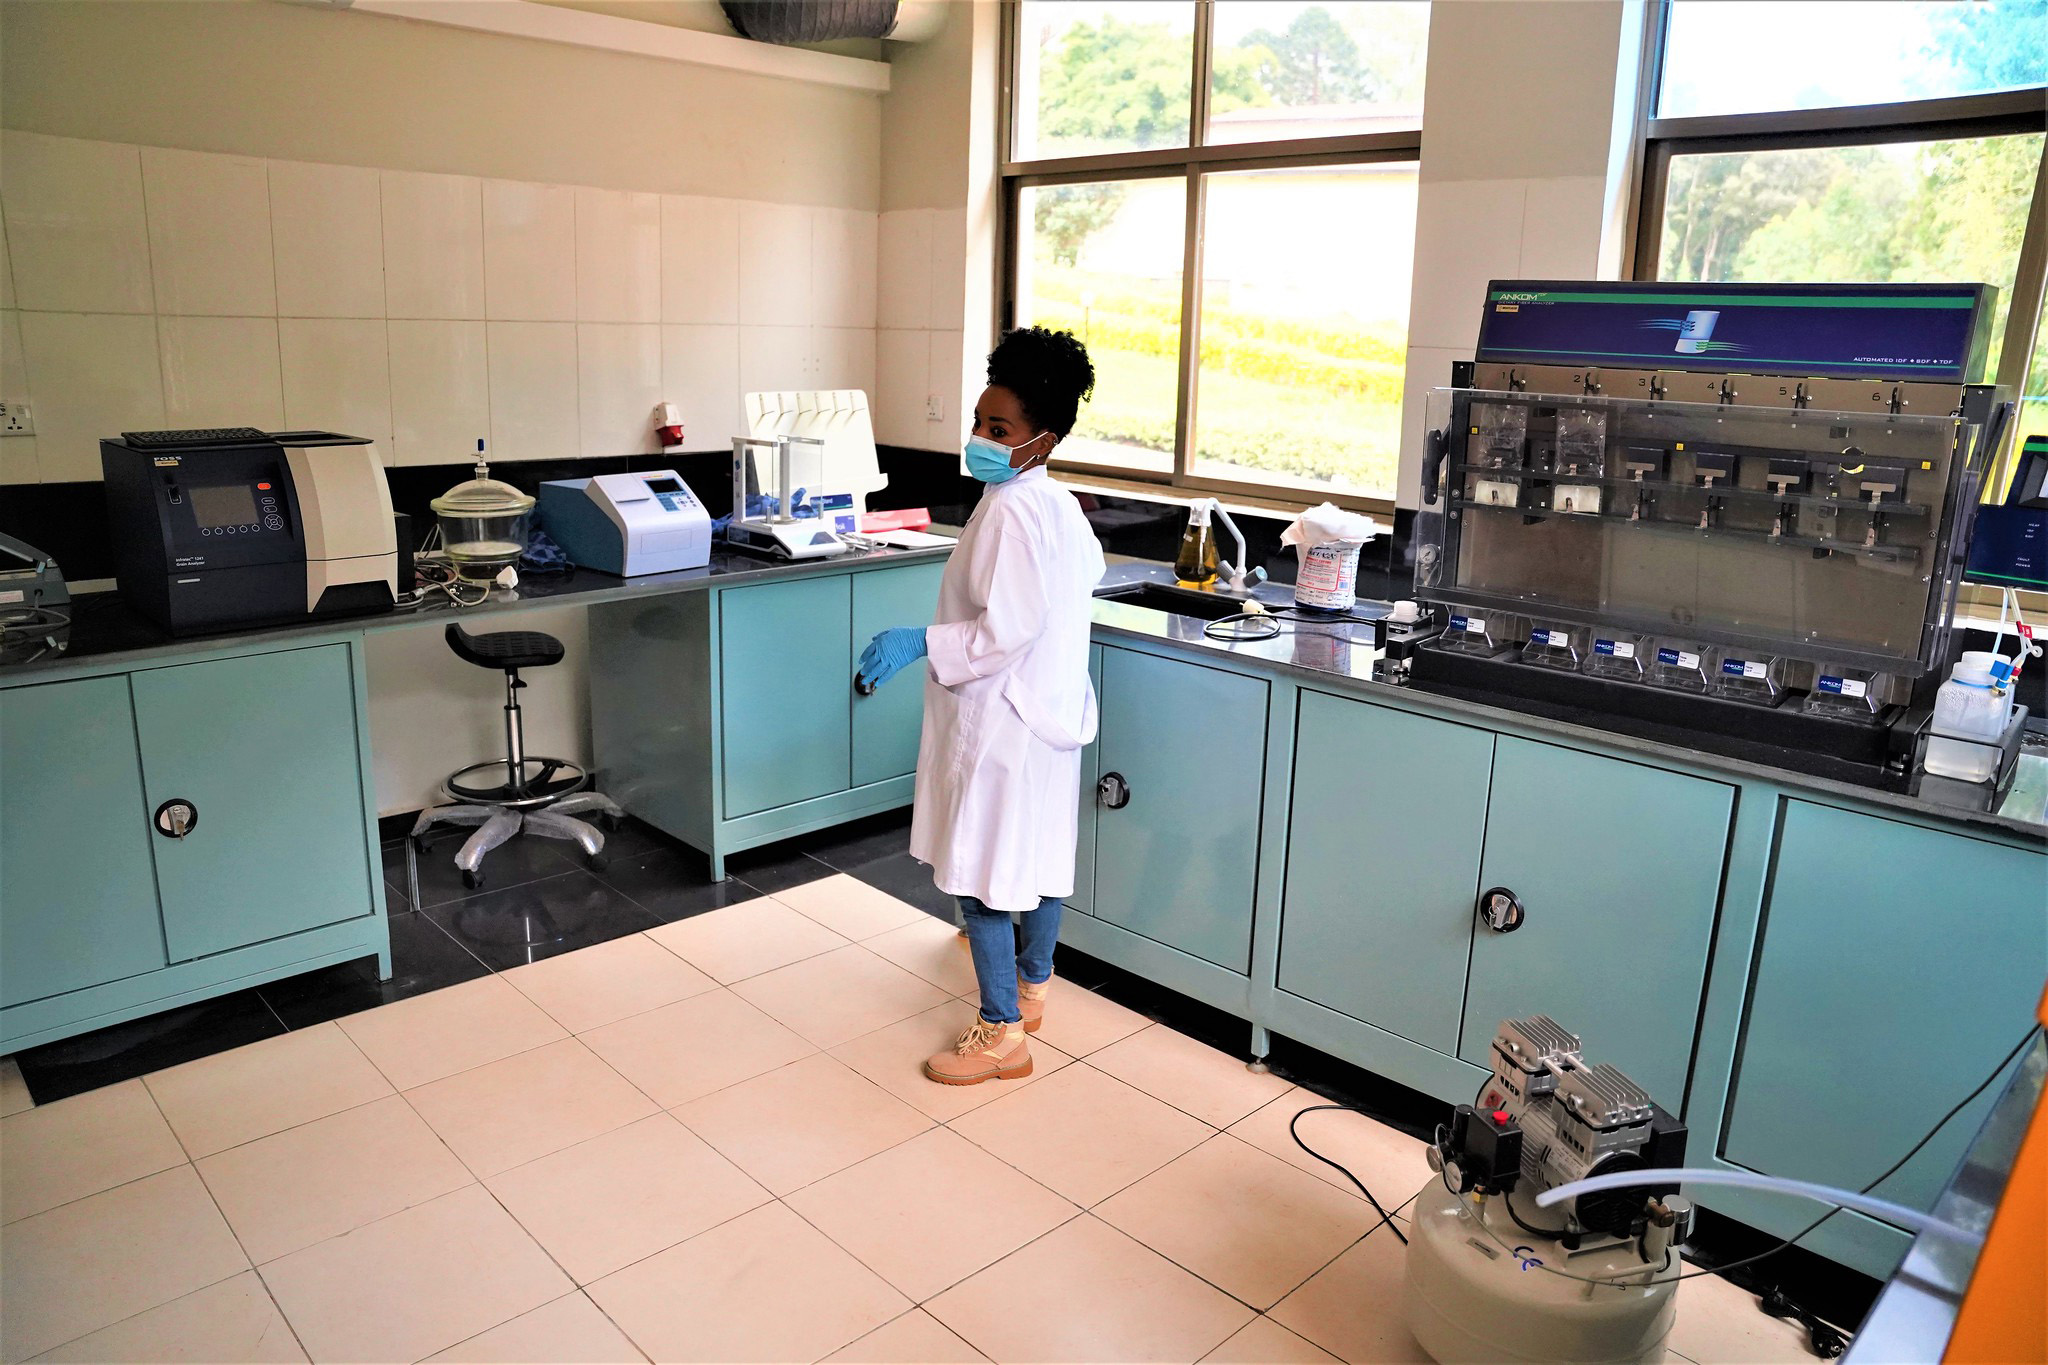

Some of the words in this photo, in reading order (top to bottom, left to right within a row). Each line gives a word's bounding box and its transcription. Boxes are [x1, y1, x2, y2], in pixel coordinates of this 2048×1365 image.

[1573, 374, 1581, 383] 2
[1638, 378, 1646, 387] 3
[1707, 382, 1715, 390] 4
[1779, 387, 1787, 396] 5
[1872, 393, 1881, 401] 6
